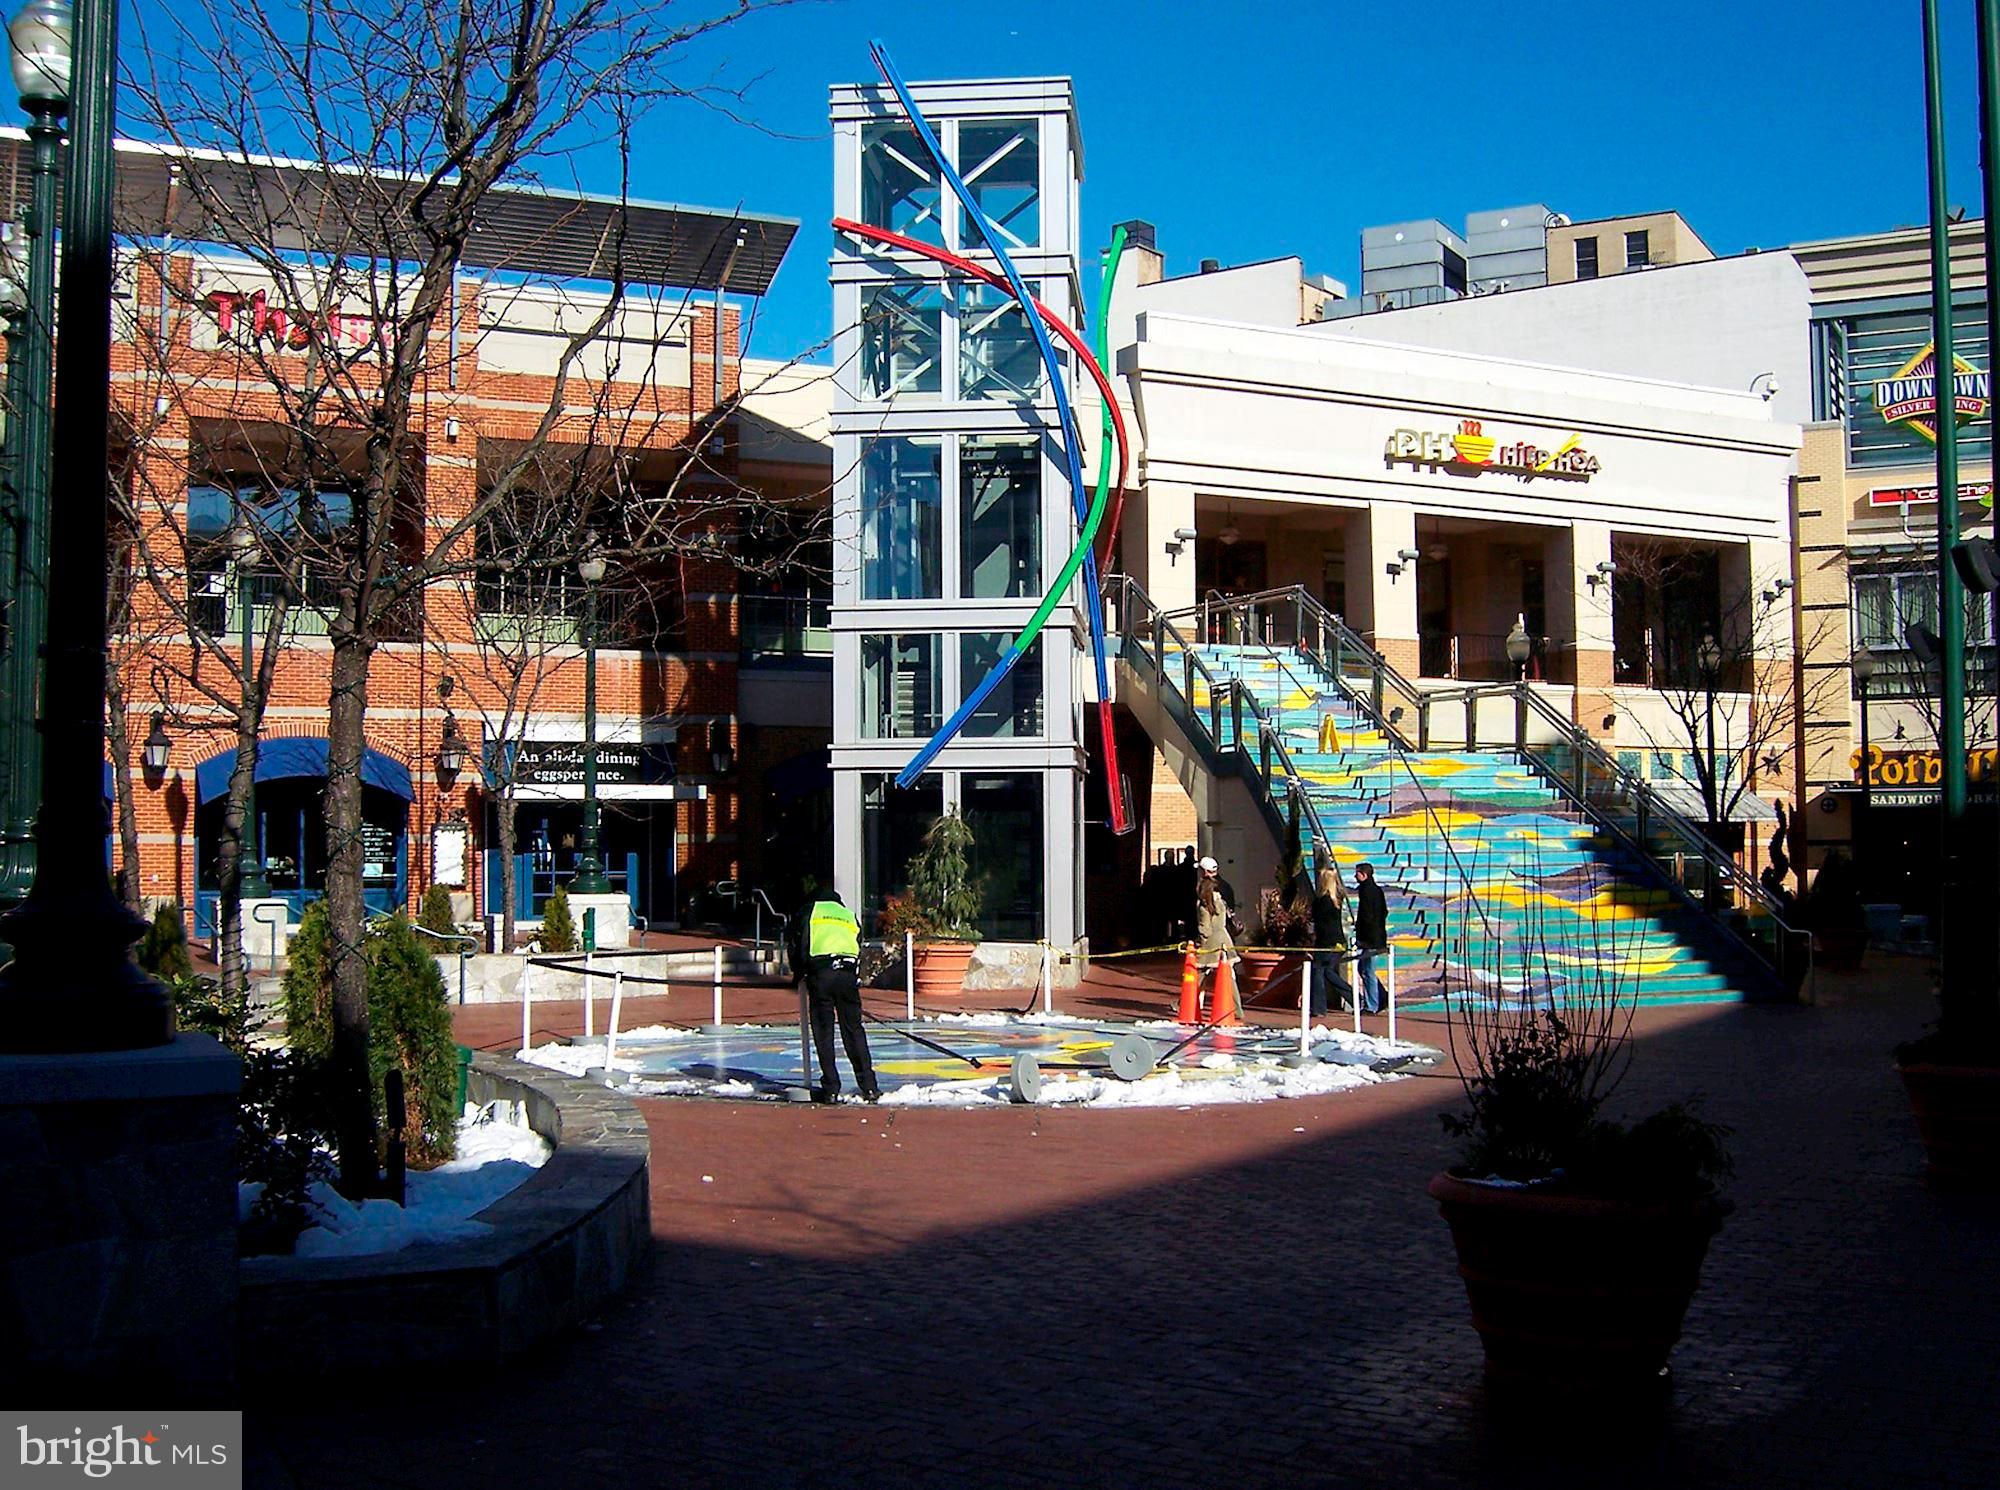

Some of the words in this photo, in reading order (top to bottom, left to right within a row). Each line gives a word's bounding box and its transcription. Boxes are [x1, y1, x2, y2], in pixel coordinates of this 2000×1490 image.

[1877, 374, 1990, 407] DOWNWN
[1890, 401, 1932, 417] SILVER
[517, 750, 540, 763] An
[595, 750, 640, 766] dining
[533, 770, 625, 783] eggspernce.
